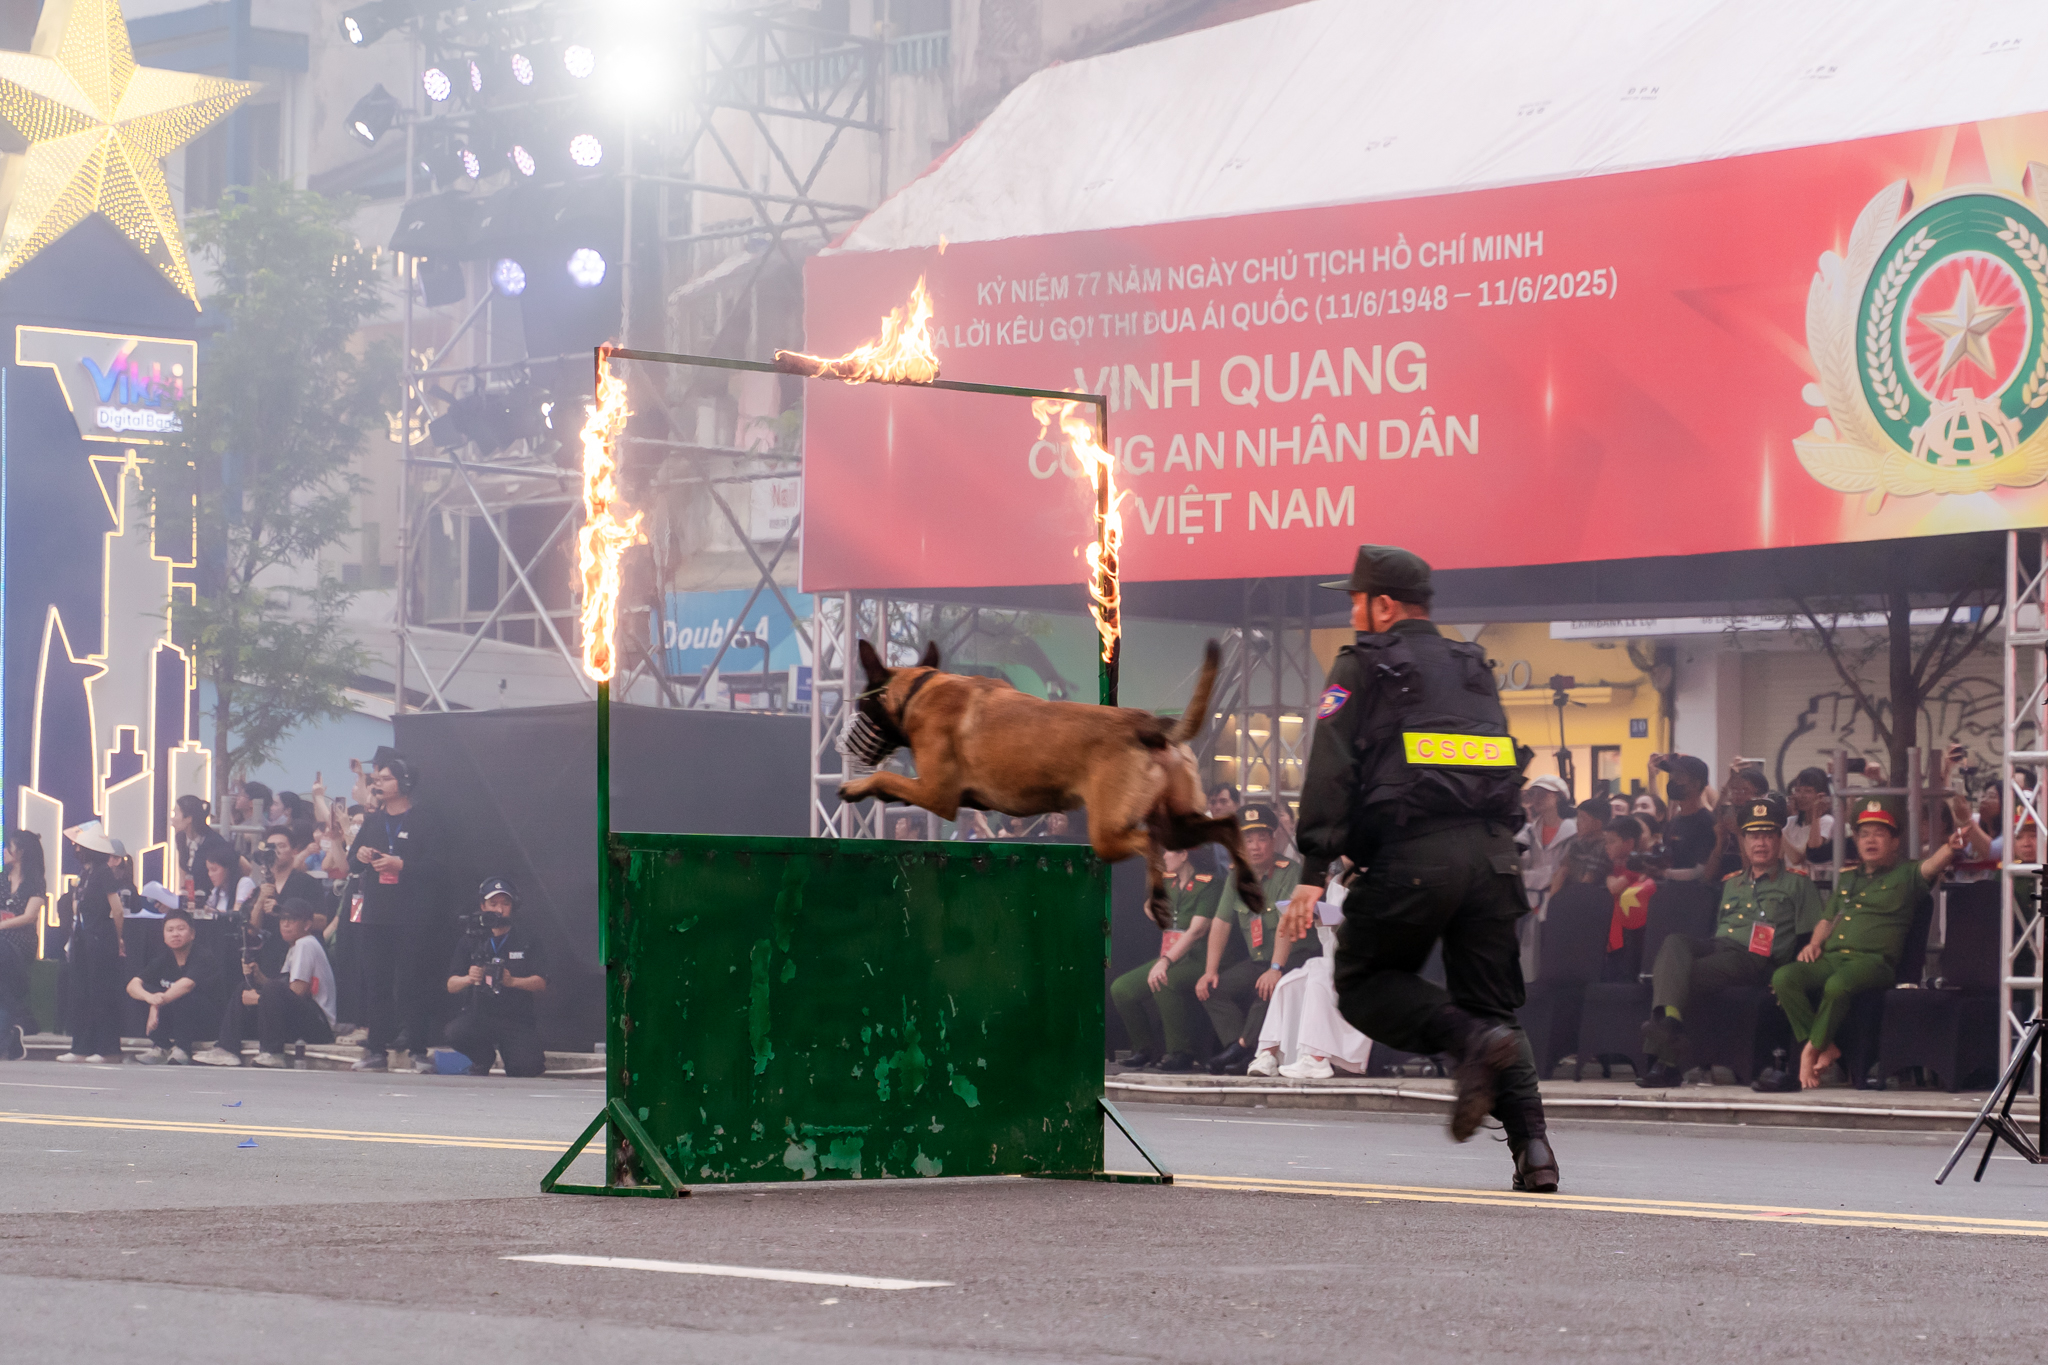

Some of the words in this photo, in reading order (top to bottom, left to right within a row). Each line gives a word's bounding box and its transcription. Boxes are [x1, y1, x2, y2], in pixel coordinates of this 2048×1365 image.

[977, 275, 1006, 306] KỶ
[1011, 272, 1069, 308] NIỆM
[1075, 272, 1101, 297] 77
[1106, 264, 1162, 295] NĂM
[1167, 257, 1238, 291] NGÀY
[1242, 248, 1298, 284] CHỦ
[1303, 249, 1365, 283] TỊCH
[1372, 232, 1412, 273] HỒ
[1418, 232, 1466, 268] CHÍ
[1472, 230, 1544, 263] MINH
[954, 317, 991, 348] LỜI
[996, 314, 1044, 345] KÊU
[1049, 315, 1094, 346] GỌI
[1098, 311, 1138, 338] THI
[1143, 306, 1196, 335] ĐUA
[1201, 300, 1226, 331] ÁI
[1231, 288, 1309, 331] QUỐC
[1315, 283, 1449, 325] (11/6/1948
[1477, 265, 1618, 307] 11/6/2025)
[81, 340, 184, 406] Vikki
[1073, 359, 1200, 414] VINH
[1219, 340, 1428, 408] QUANG
[99, 410, 144, 428] Digital
[1163, 430, 1225, 473] AN
[1235, 412, 1368, 469] NHÂN
[1378, 405, 1479, 461] DÂN
[1134, 483, 1232, 545] VIỆT
[1248, 485, 1355, 531] NAM
[1417, 738, 1500, 761] CSCĐ
